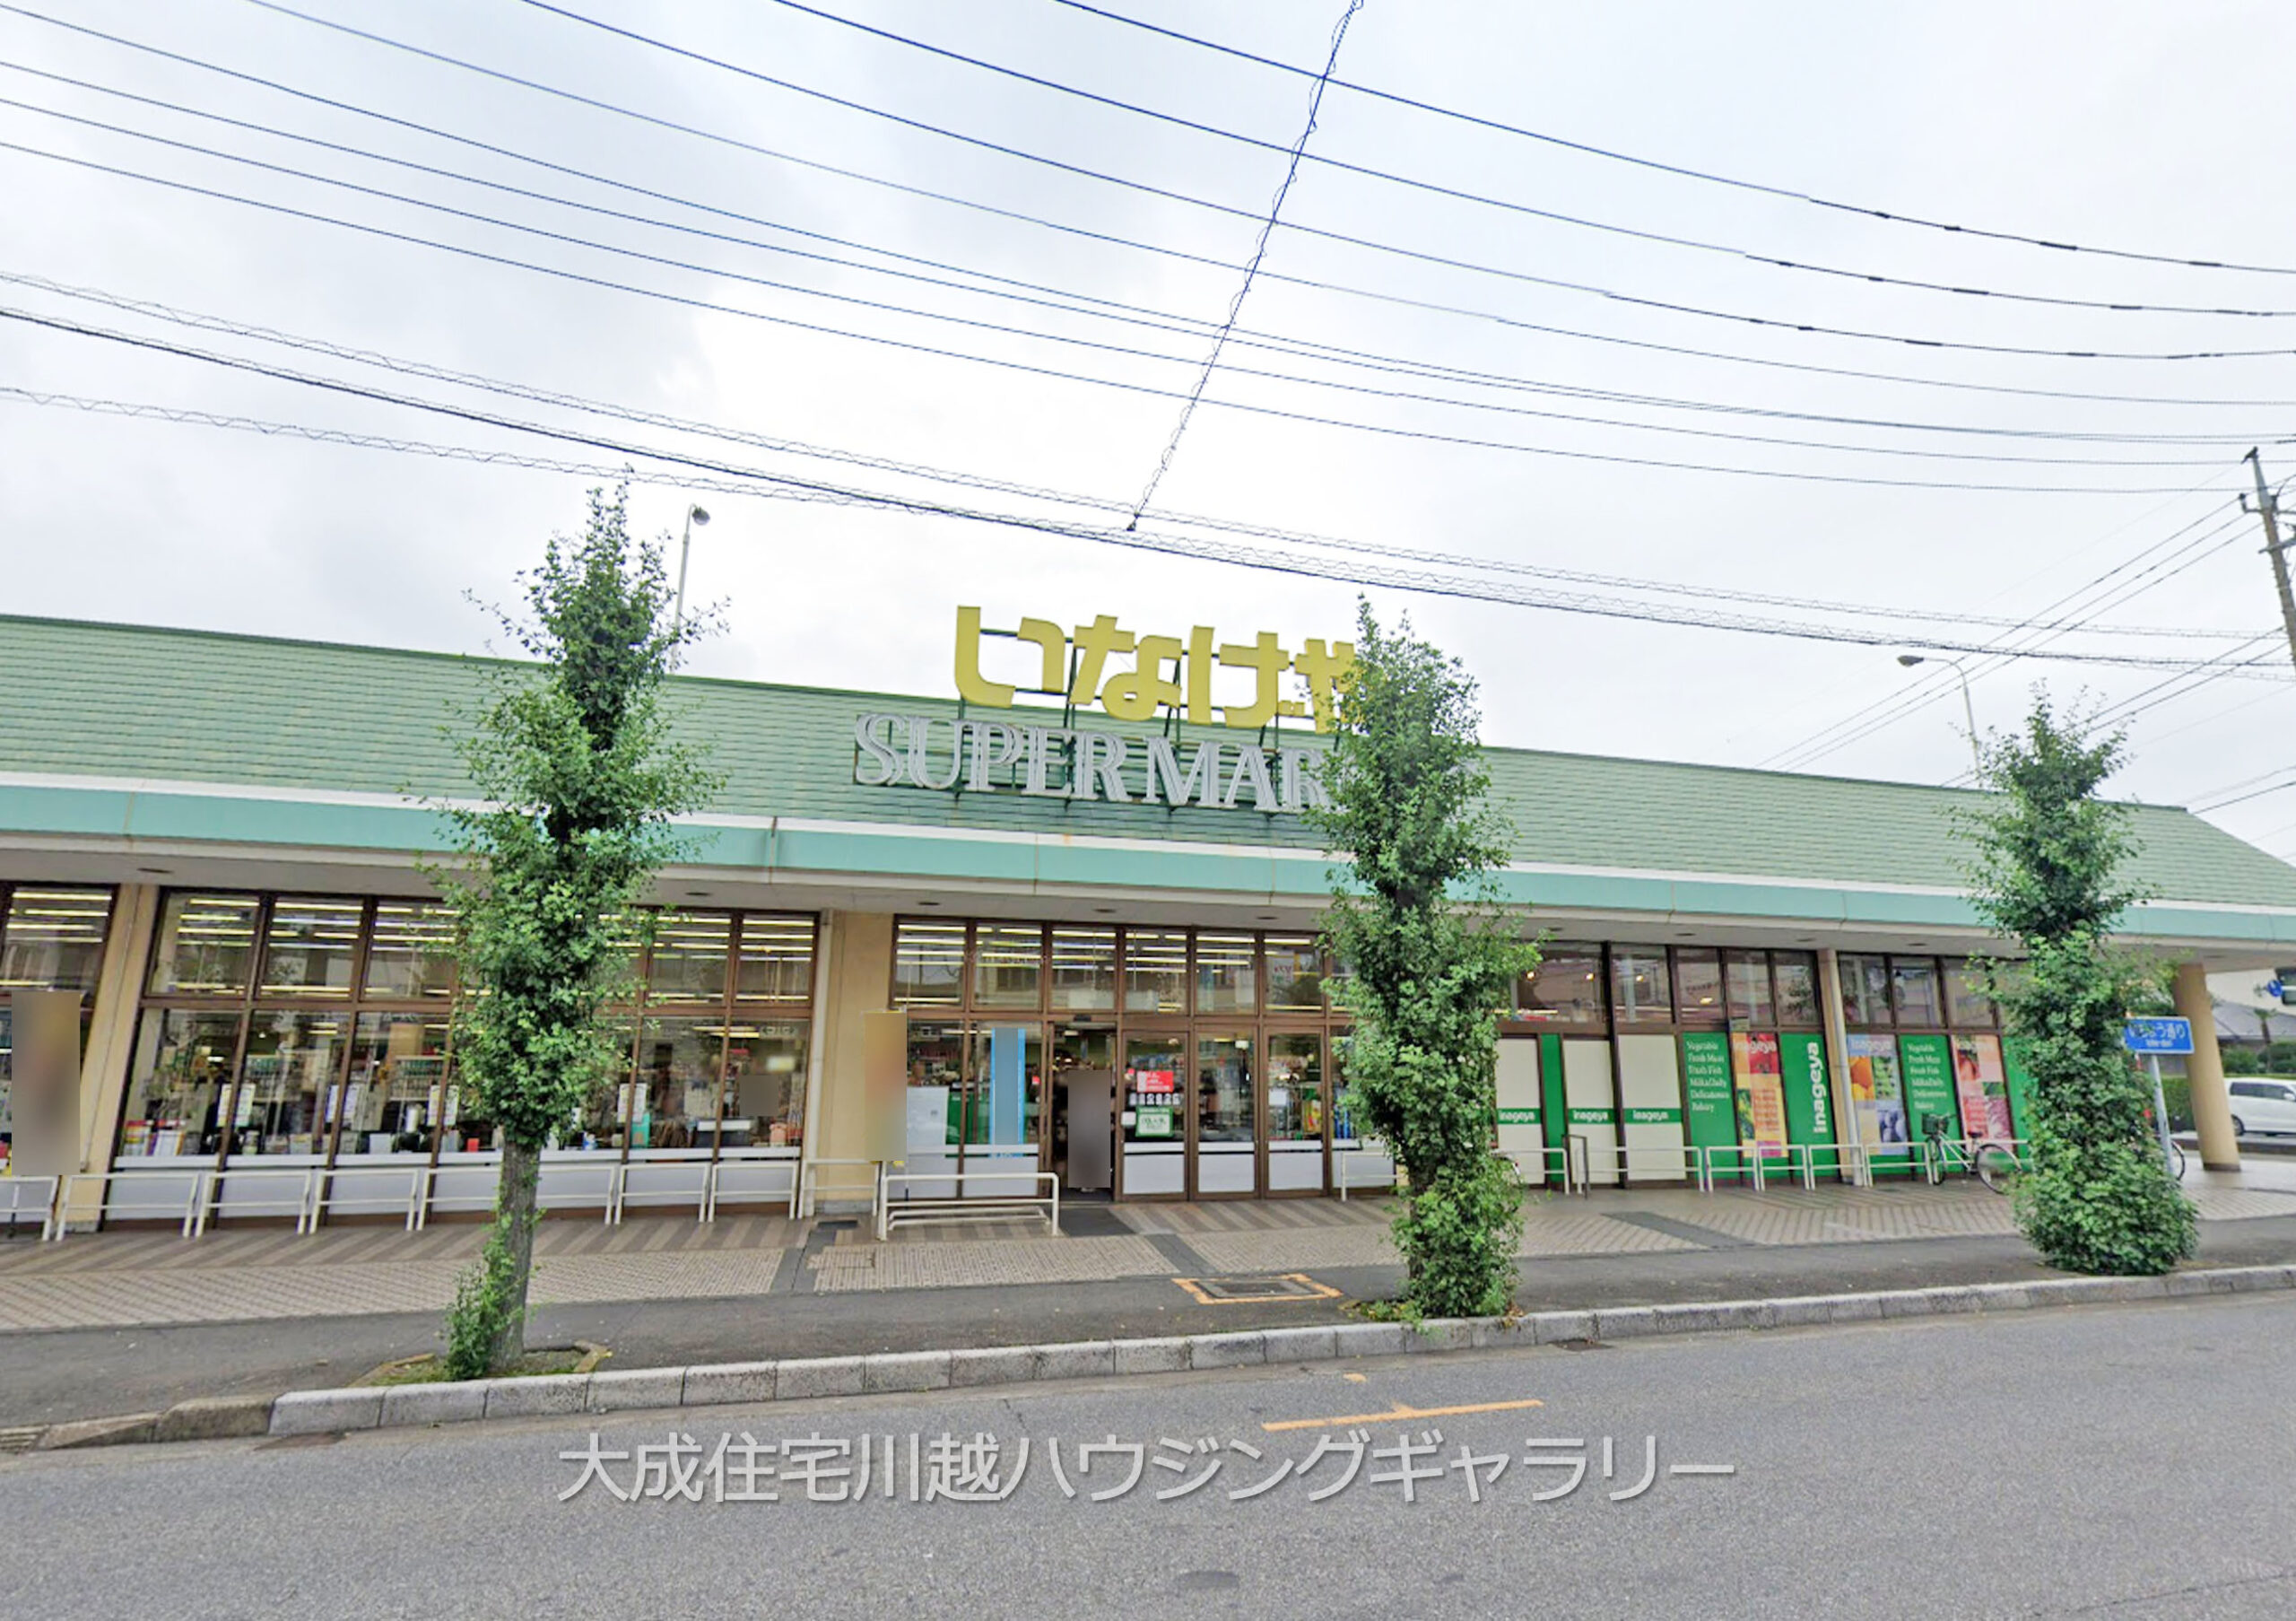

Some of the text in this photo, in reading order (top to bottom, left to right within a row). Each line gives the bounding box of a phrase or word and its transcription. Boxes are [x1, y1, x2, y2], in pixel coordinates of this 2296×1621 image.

[954, 606, 1365, 735] いなげや
[852, 713, 1336, 812] SUPERMAR
[1807, 1041, 1829, 1133] inageya
[1499, 1111, 1535, 1122] inageya
[1573, 1111, 1609, 1122] inageya
[1632, 1110, 1669, 1121] inageya
